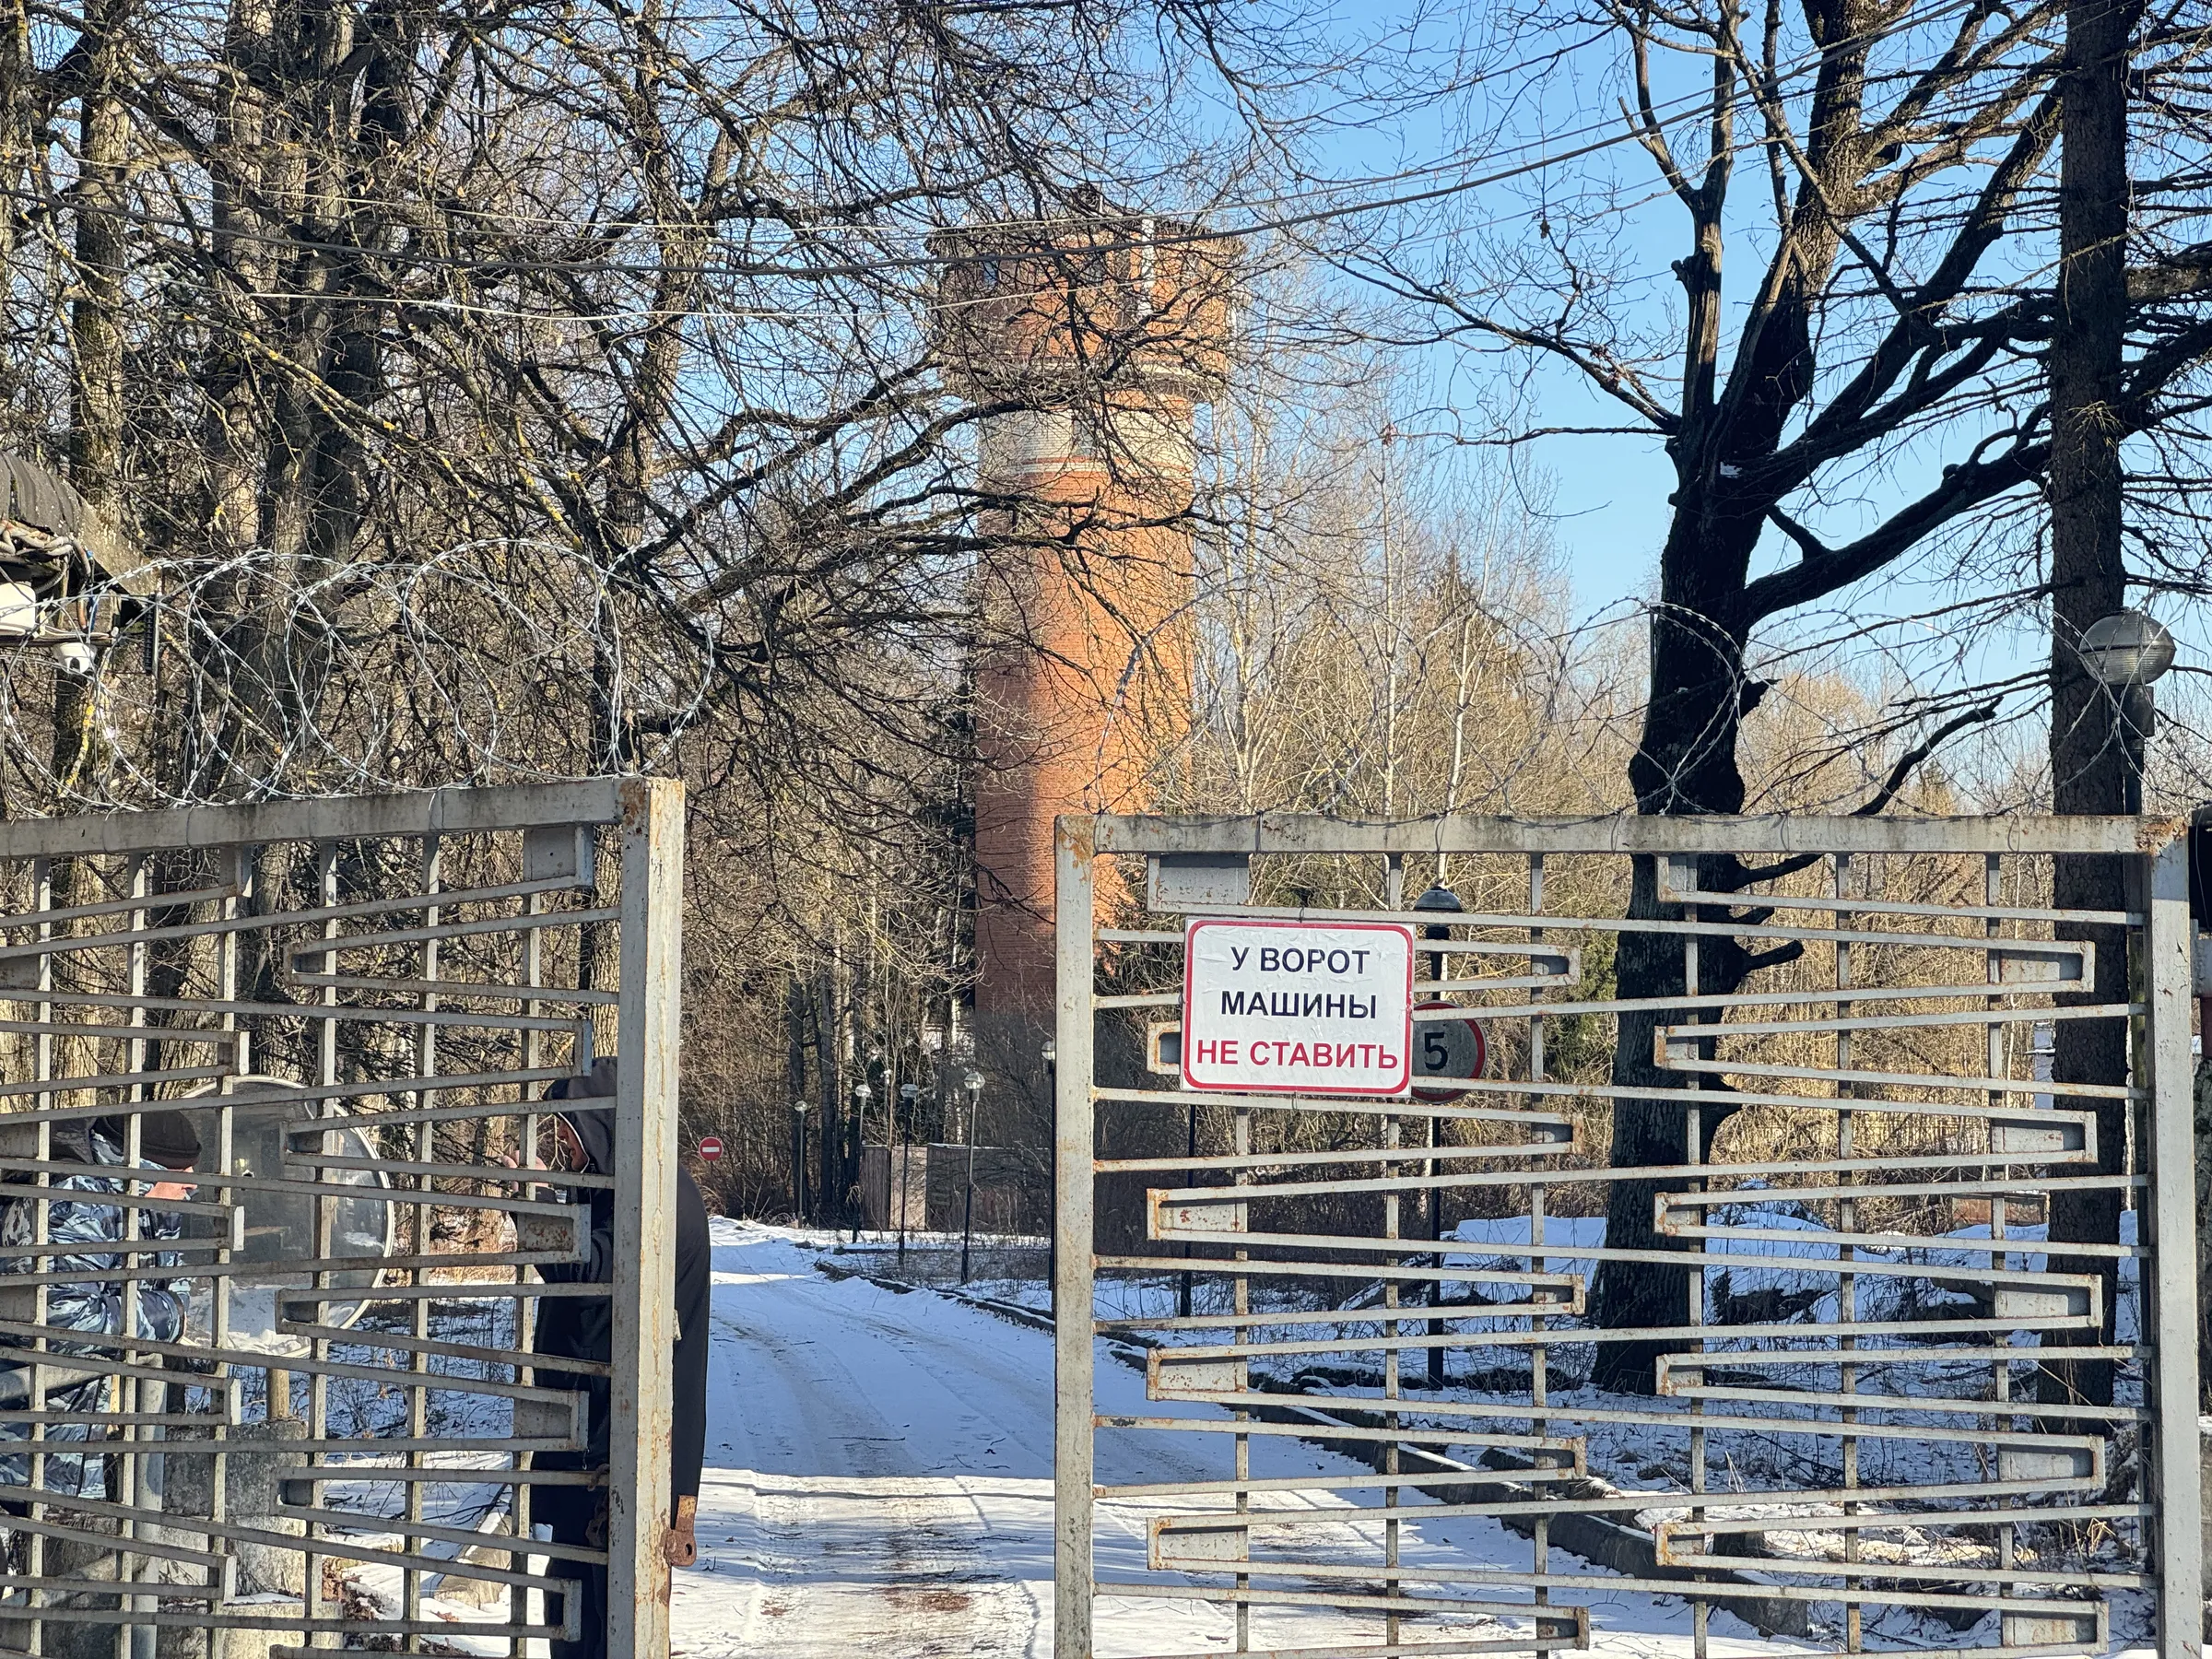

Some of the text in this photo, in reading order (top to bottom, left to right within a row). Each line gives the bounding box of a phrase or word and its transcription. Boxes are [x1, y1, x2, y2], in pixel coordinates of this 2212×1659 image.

[1230, 946, 1371, 974] У ВОРОТ
[1221, 990, 1377, 1018] МАШИНЫ
[1197, 1040, 1398, 1069] НЕ СТАВИТЬ
[1424, 1031, 1449, 1071] 5
